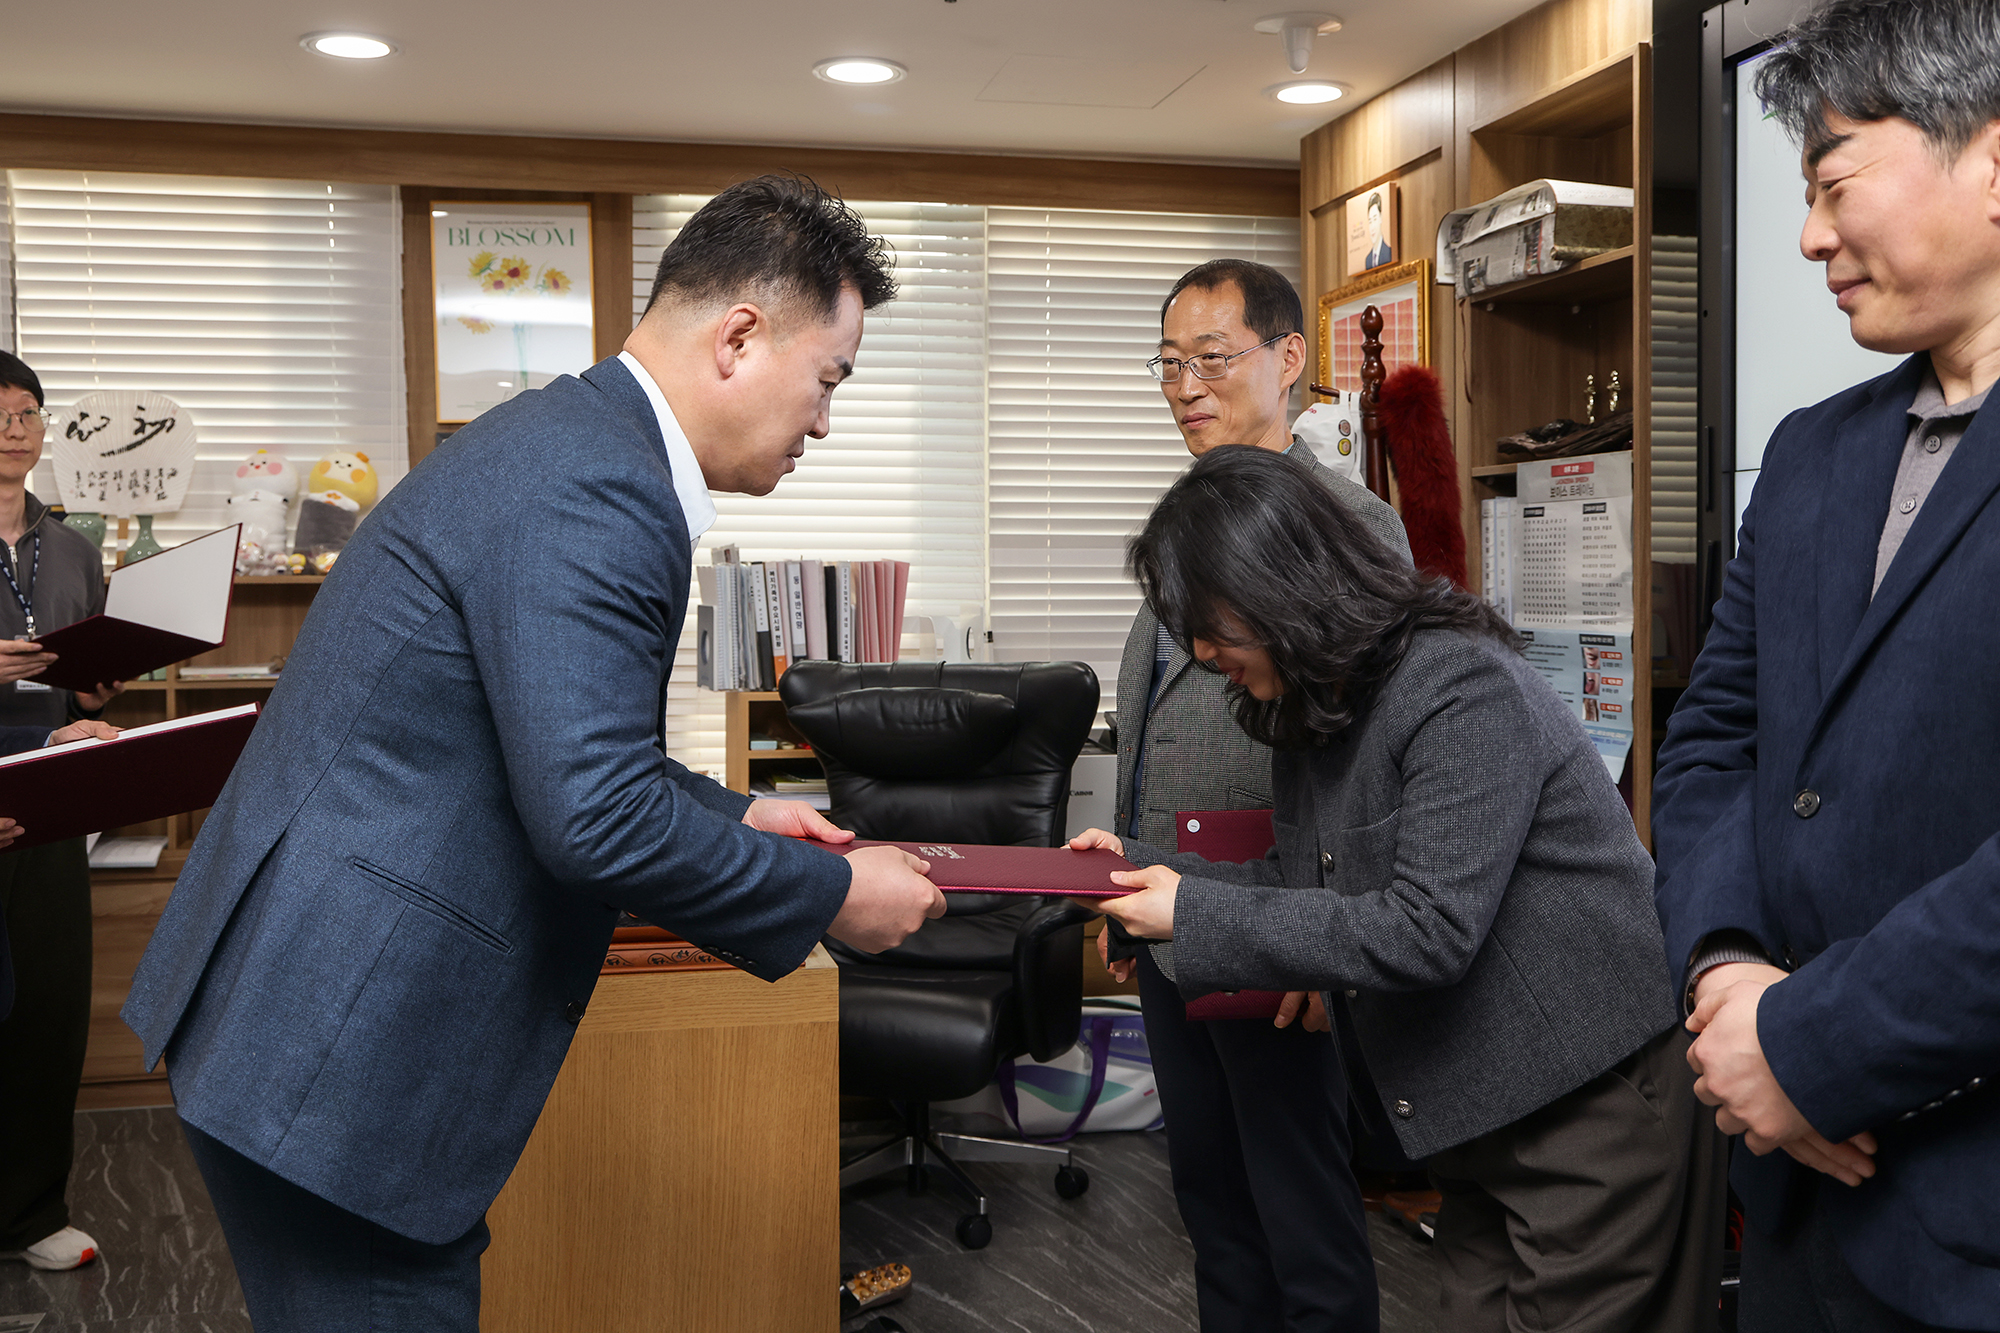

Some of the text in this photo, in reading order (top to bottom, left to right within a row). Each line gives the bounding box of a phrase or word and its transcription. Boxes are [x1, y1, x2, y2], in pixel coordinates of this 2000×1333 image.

[448, 226, 575, 248] BLOSSOM
[1550, 483, 1595, 498] 보이스 트레이닝
[769, 570, 782, 647] 복지가족국 주요시설 현황
[1069, 789, 1094, 797] Canon
